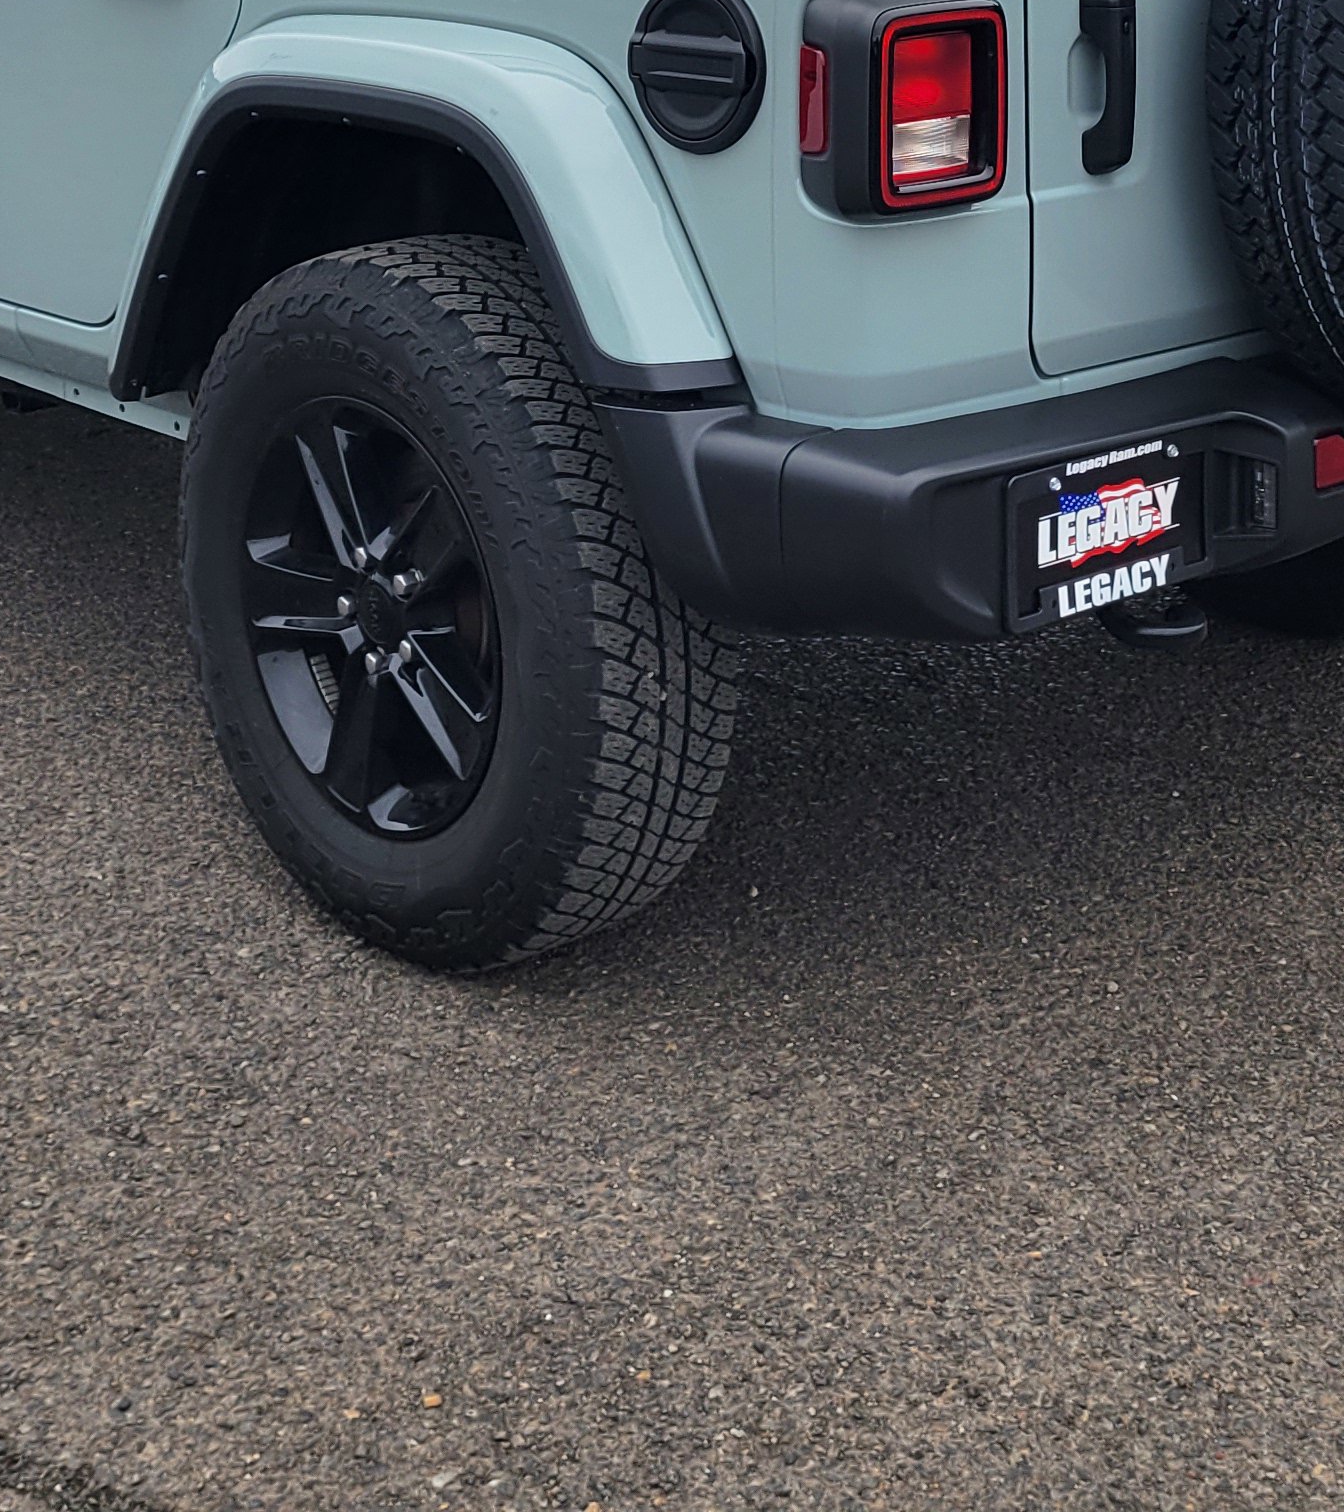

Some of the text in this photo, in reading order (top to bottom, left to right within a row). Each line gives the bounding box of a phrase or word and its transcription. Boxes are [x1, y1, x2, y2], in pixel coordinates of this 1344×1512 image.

[1065, 454, 1109, 476] Legacy
[1038, 481, 1179, 565] LEGACY
[1058, 554, 1170, 618] LEGACY
